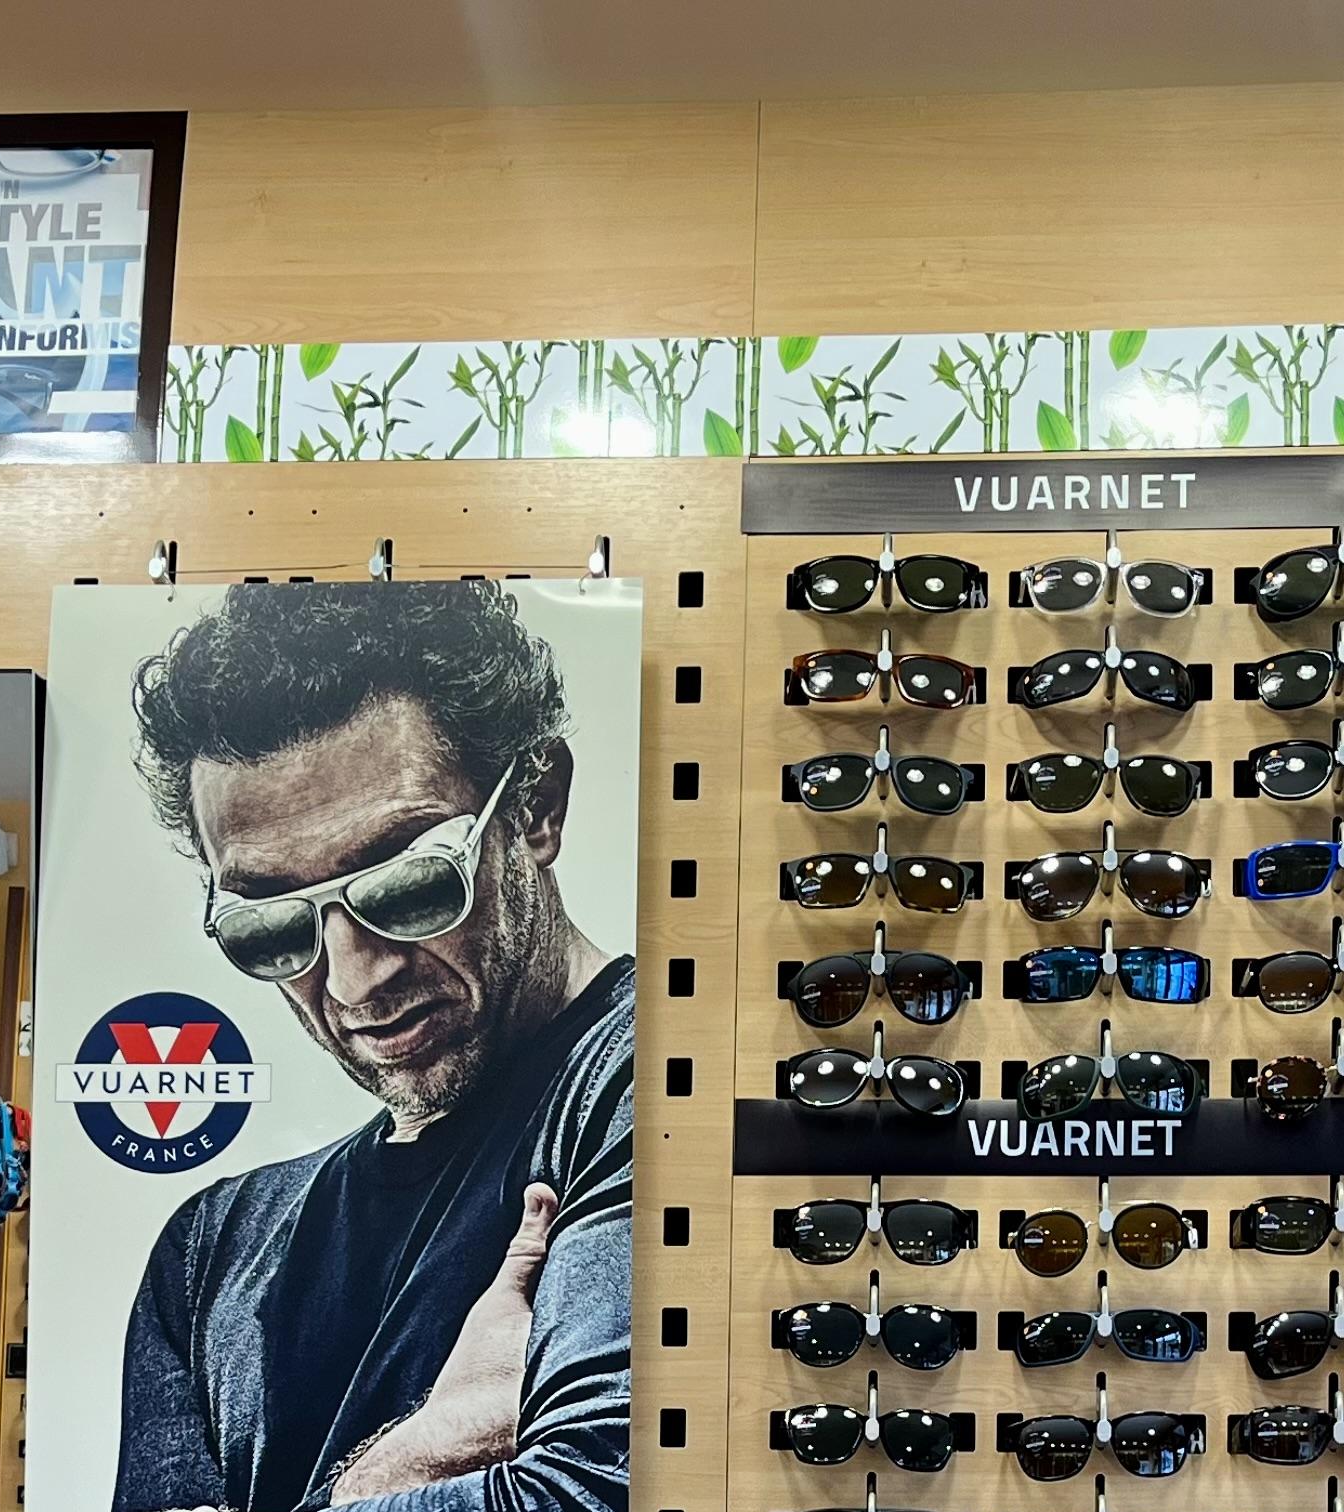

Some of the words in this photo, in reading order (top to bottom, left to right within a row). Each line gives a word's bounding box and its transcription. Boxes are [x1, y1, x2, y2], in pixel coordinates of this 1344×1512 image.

[953, 472, 1197, 513] VUARNET
[73, 1070, 255, 1095] VUARNET
[111, 1132, 214, 1163] FRANCE
[967, 1119, 1183, 1158] VUARNET
